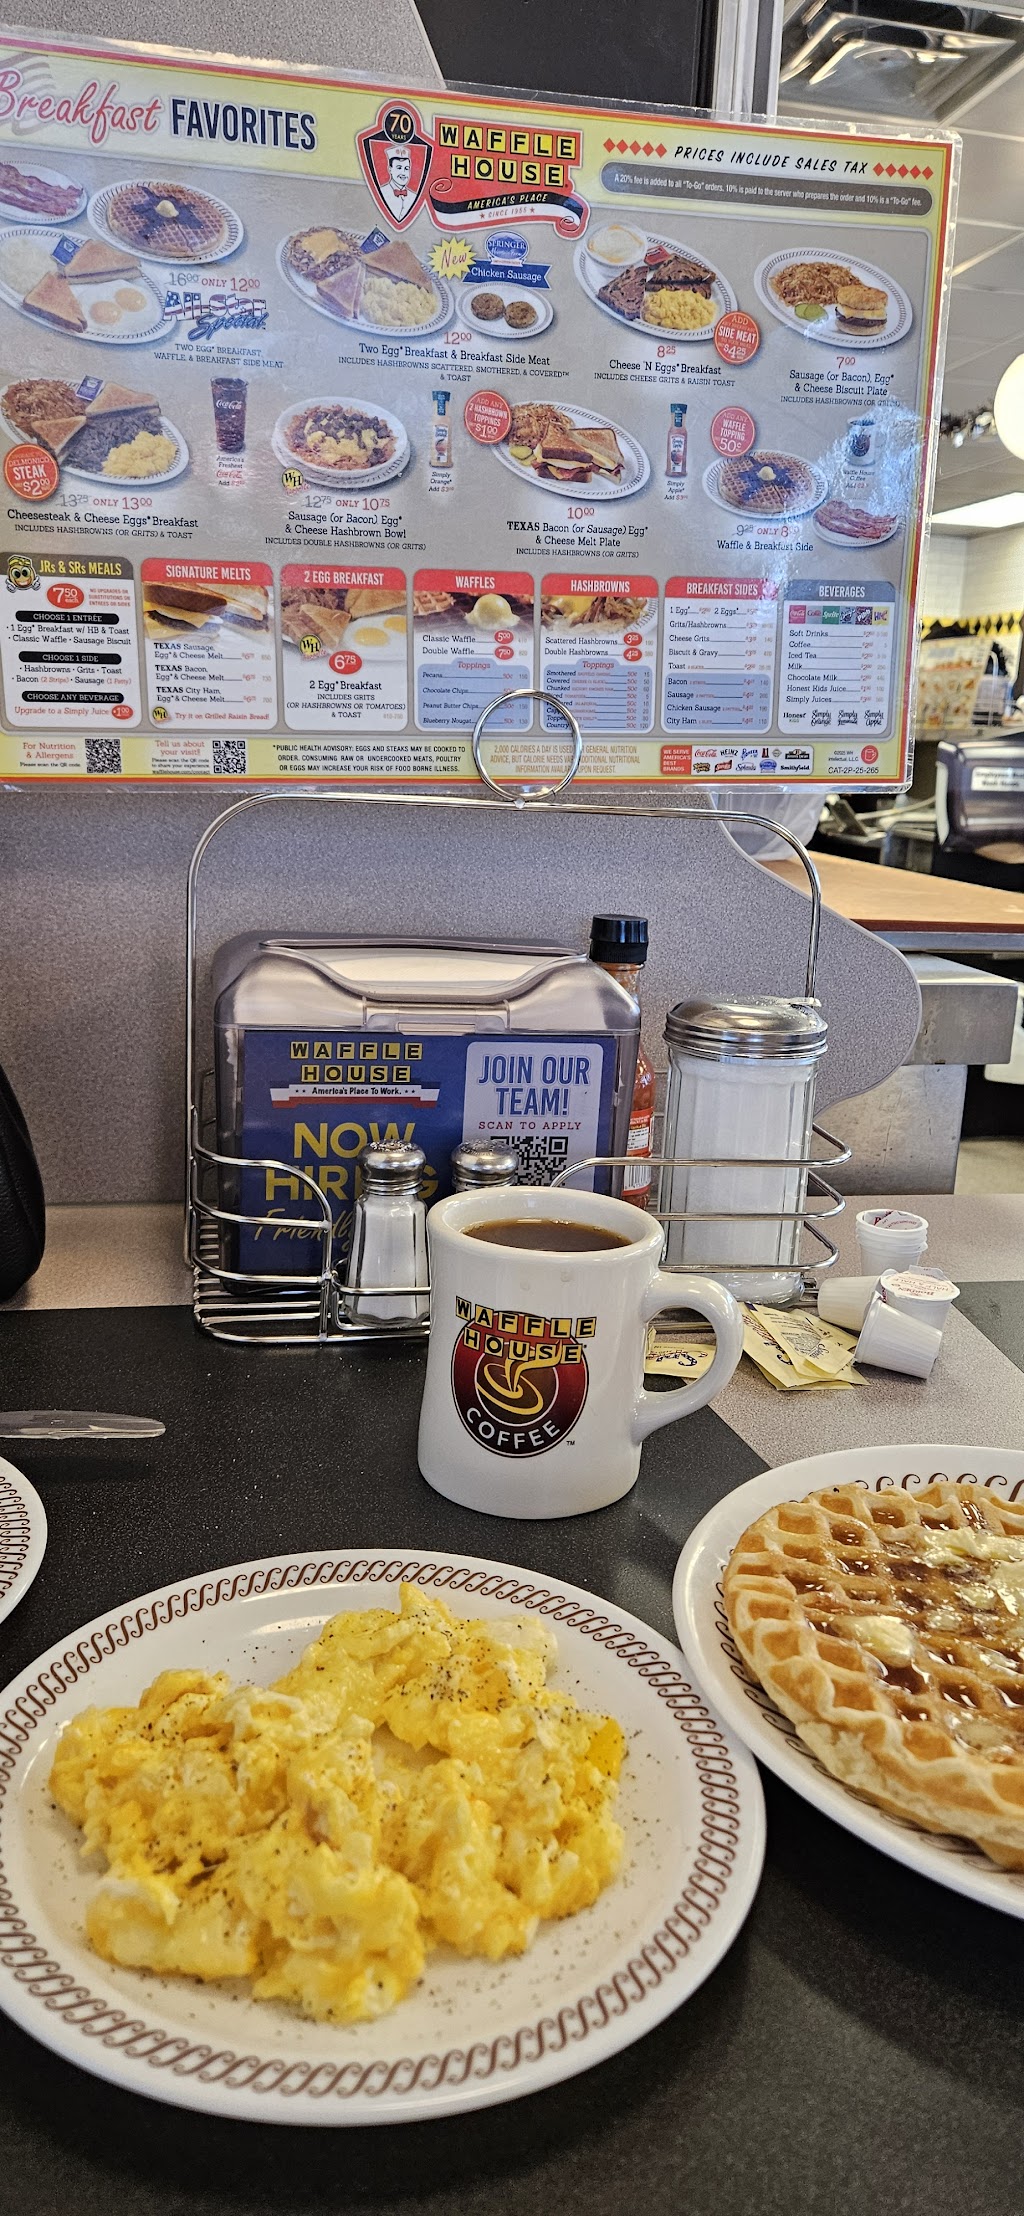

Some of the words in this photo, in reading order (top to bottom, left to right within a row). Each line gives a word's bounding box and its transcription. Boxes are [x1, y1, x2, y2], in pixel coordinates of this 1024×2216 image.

[0, 72, 161, 144] Breakfast
[171, 98, 316, 151] FAVORITES
[389, 113, 412, 134] 70
[392, 134, 407, 142] YEARS
[441, 124, 574, 160] WAFFLE
[673, 146, 724, 163] PRICES
[729, 151, 791, 169] INCLUDE
[794, 157, 838, 174] SALES
[843, 162, 869, 177] TAX
[453, 155, 563, 185] HOUSE
[620, 174, 634, 184] 20%
[633, 175, 643, 184] fee
[650, 177, 667, 186] added
[667, 178, 674, 187] to
[674, 179, 682, 187] all
[726, 184, 737, 193] 10%
[744, 185, 757, 195] paid
[764, 186, 773, 196] the
[774, 189, 791, 197] server
[792, 190, 804, 198] who
[804, 191, 829, 201] prepares
[829, 192, 839, 201] the
[840, 193, 854, 202] order
[855, 194, 865, 203] and
[867, 195, 879, 204] 10%
[467, 195, 515, 211] AMERICA'S
[519, 192, 549, 206] PLACE
[488, 209, 509, 219] SINCE
[487, 238, 526, 250] SPRINGER
[440, 249, 467, 270] New
[471, 266, 505, 279] Chicken
[507, 269, 542, 282] Sausage
[718, 325, 734, 339] SIDE
[735, 329, 757, 344] MEAT
[359, 343, 379, 354] Two
[404, 346, 448, 359] Breakfast
[450, 350, 458, 359] &
[460, 350, 503, 363] Breakfast
[506, 353, 526, 364] Side
[529, 355, 550, 366] Meat
[338, 357, 376, 367] INCLUDES
[377, 358, 429, 370] HASHBROWNS
[609, 359, 641, 370] Cheese
[681, 363, 721, 375] Breakfast
[789, 370, 825, 383] Sausage
[826, 371, 840, 382] (or
[794, 383, 801, 392] &
[803, 383, 833, 394] Cheese
[835, 384, 864, 395] Biscuit
[867, 386, 888, 397] Plate
[722, 420, 746, 434] WAFFLE
[720, 429, 746, 443] TOPPING
[12, 464, 47, 481] STEAK
[7, 508, 71, 522] Cheesesteak
[74, 512, 81, 522] &
[84, 513, 120, 524] Cheese
[152, 516, 199, 529] Breakfast
[288, 511, 327, 524] Sausage
[329, 512, 343, 523] (or
[346, 513, 378, 526] Bacon)
[285, 524, 292, 534] &
[294, 525, 328, 536] Cheese
[330, 526, 382, 539] Hashbrown
[384, 529, 406, 540] Bowl
[507, 521, 540, 533] TEXAS
[542, 522, 570, 534] Bacon
[572, 524, 585, 535] (or
[586, 524, 626, 538] Sausage)
[535, 535, 542, 545] &
[544, 535, 575, 547] Cheese
[577, 536, 597, 547] Melt
[599, 537, 621, 548] Plate
[717, 540, 745, 551] Waffle
[746, 541, 752, 551] &
[754, 540, 794, 553] Breakfast
[795, 542, 814, 553] Side
[40, 560, 56, 575] JRs
[59, 561, 66, 574] &
[68, 561, 86, 576] SRs
[89, 562, 122, 577] MEALS
[166, 564, 219, 581] SIGNATURE
[221, 567, 251, 582] MELTS
[304, 570, 310, 581] 2
[313, 571, 331, 585] EGG
[333, 572, 384, 587] BREAKFAST
[455, 575, 496, 590] WAFFLES
[570, 579, 630, 594] HASHBROWNS
[687, 582, 733, 596] BREAKFAST
[735, 583, 758, 597] SIDES
[819, 585, 865, 598] BEVERAGES
[32, 613, 66, 623] CHOOSE
[73, 613, 103, 624] ENTRÉE
[422, 634, 450, 644] Classic
[451, 635, 476, 644] Waffle
[669, 634, 692, 643] Cheese
[693, 635, 710, 643] Grits
[789, 630, 804, 638] Soft
[806, 630, 829, 638] Drinks
[422, 647, 449, 656] Double
[450, 648, 475, 657] Waffle
[788, 641, 811, 649] Coffee
[668, 649, 691, 657] Biscuit
[698, 649, 719, 659] Gravy
[788, 652, 803, 660] Iced
[805, 652, 817, 660] Tea
[309, 680, 316, 690] 2
[340, 681, 382, 693] Breakfast
[720, 748, 739, 757] HEINZ
[780, 764, 809, 773] Smithfield
[828, 767, 879, 775] CAT-2P-25-265
[291, 1042, 422, 1059] WAFFLE
[302, 1066, 410, 1081] HOUSE
[478, 1055, 534, 1084] JOIN
[542, 1056, 591, 1085] OUR
[312, 1087, 348, 1096] America's
[349, 1087, 370, 1096] Place
[371, 1088, 379, 1096] To
[380, 1088, 402, 1096] Work.
[495, 1087, 569, 1116] TEAM!
[478, 1121, 513, 1131] SCAN
[520, 1121, 536, 1131] TO
[543, 1121, 582, 1132] APPLY
[294, 1122, 416, 1159] NOW
[265, 1165, 439, 1201] HIRIG
[456, 1297, 595, 1338] WAFFLE
[465, 1328, 581, 1362] HOUSE
[466, 1407, 561, 1450] COFFEE
